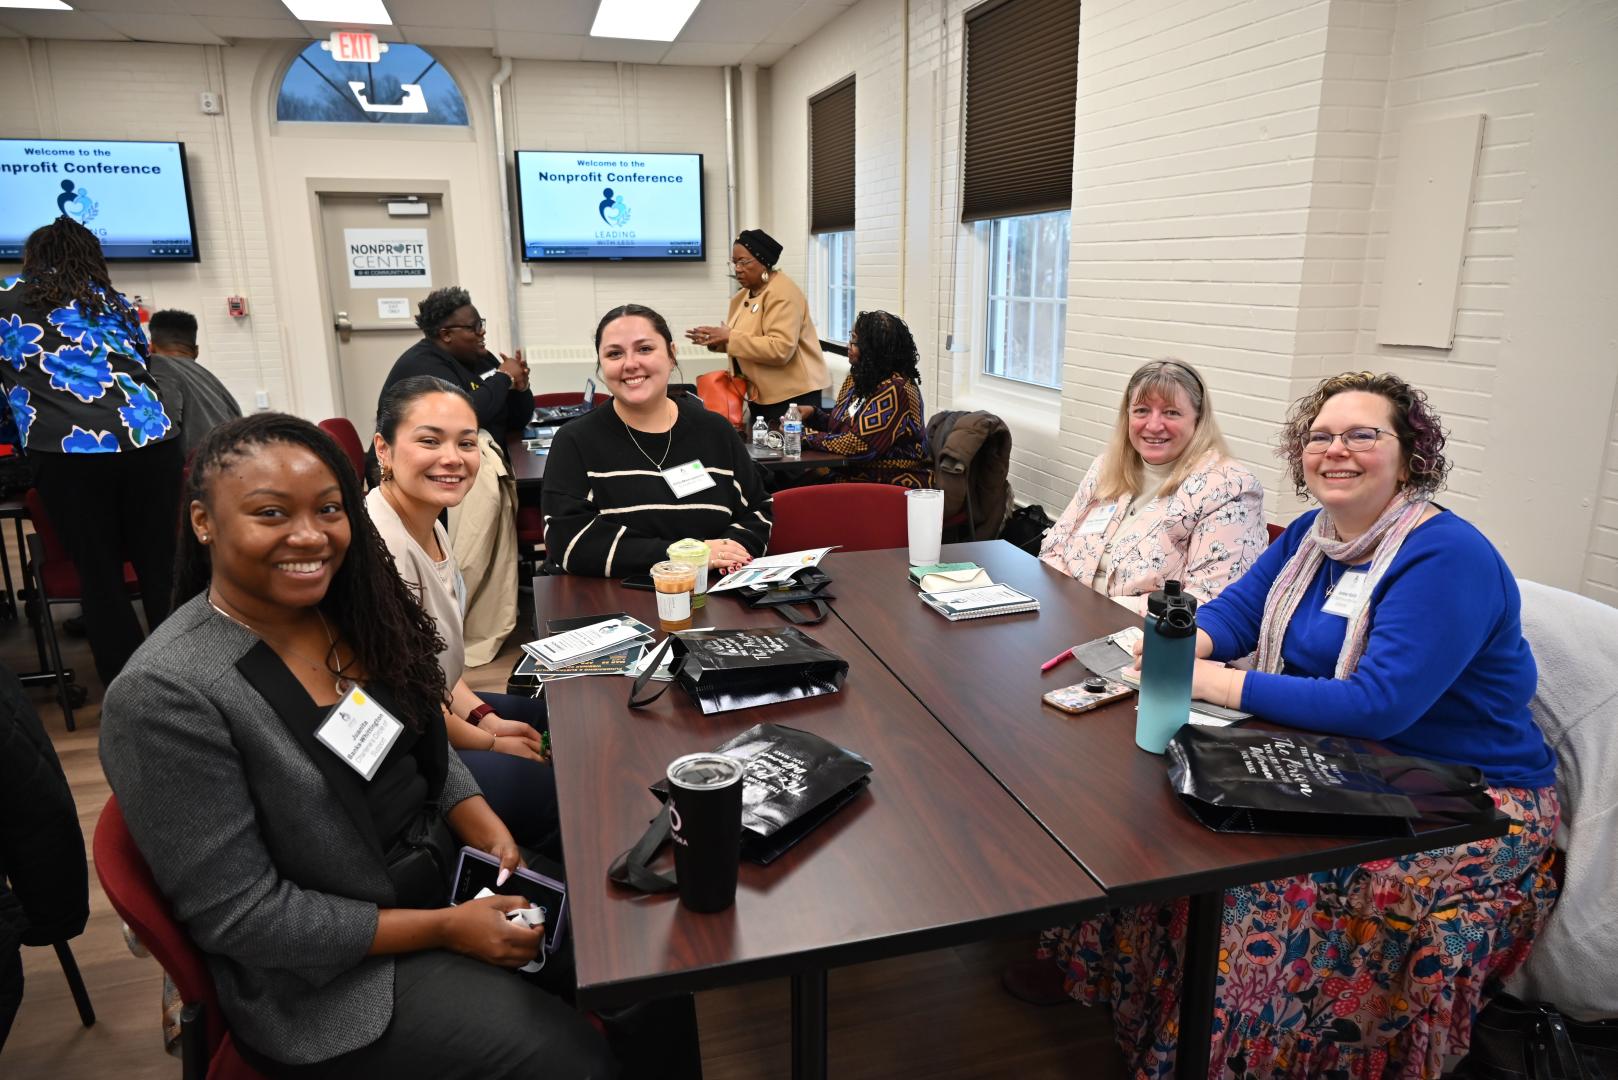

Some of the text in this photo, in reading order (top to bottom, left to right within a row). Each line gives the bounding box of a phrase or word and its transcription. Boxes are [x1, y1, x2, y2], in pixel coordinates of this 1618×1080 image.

[339, 32, 372, 60] EXIT
[24, 148, 75, 156] Welcome
[64, 162, 161, 174] Conference
[631, 160, 645, 168] the
[538, 172, 684, 184] Nonprofit Conference
[594, 231, 636, 239] LEADING
[352, 256, 426, 268] CENTER
[352, 720, 368, 740] Juanita
[773, 750, 790, 760] MAKE
[1263, 744, 1274, 756] YOU
[1300, 746, 1310, 758] THE
[1240, 751, 1256, 774] YOU MAKE
[1249, 746, 1274, 780] Difference
[1272, 738, 1312, 798] The Person
[789, 772, 804, 781] YOU
[779, 776, 808, 796] The
